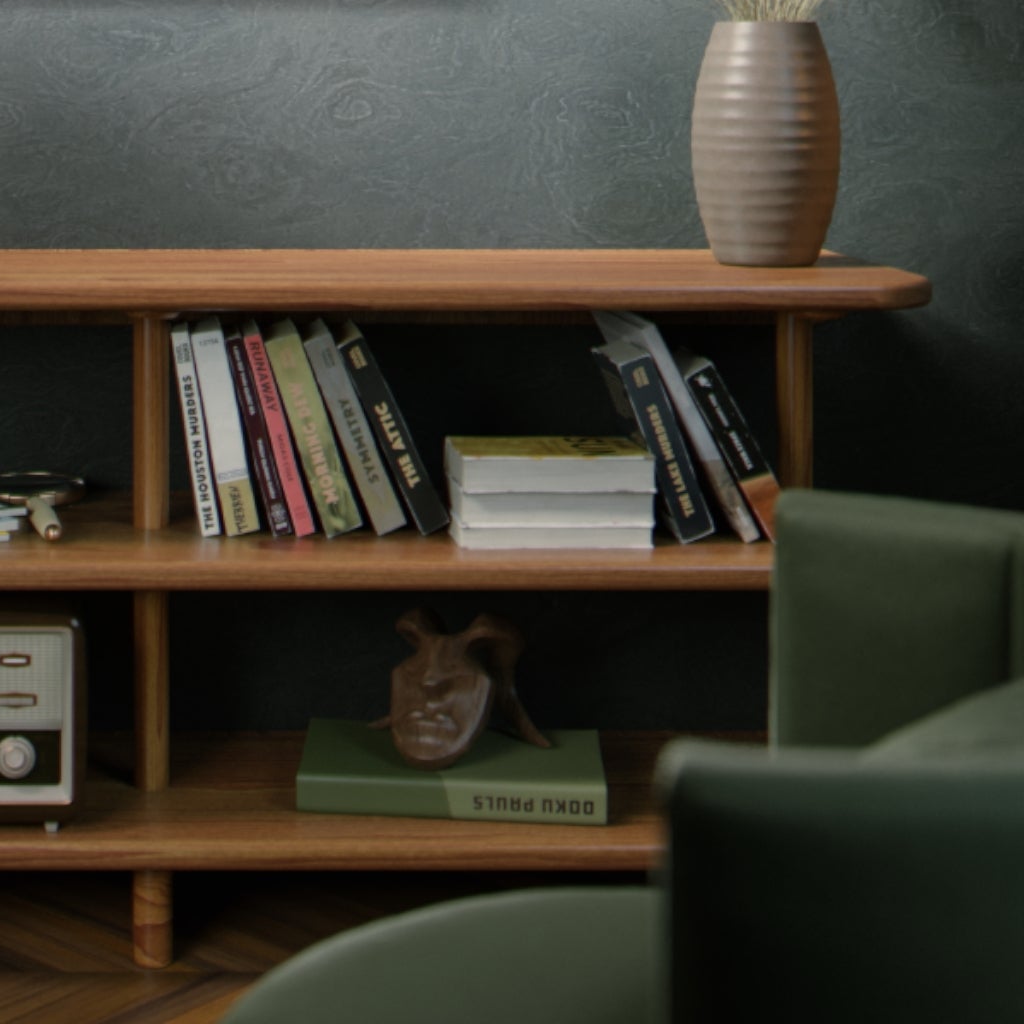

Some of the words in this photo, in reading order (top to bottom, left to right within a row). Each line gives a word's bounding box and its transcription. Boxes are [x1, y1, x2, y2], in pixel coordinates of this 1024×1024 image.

[250, 342, 277, 412] RUNAWAY
[183, 375, 202, 435] MURDERS
[374, 402, 405, 451] ATTIC
[340, 400, 379, 483] SYMMETRY
[646, 403, 674, 461] MURDERS
[191, 440, 209, 502] HOUSTON
[304, 422, 338, 504] MORNING
[398, 455, 421, 488] THE
[666, 462, 686, 493] LAKE
[202, 506, 214, 530] THE
[678, 493, 695, 519] THE
[473, 795, 534, 812] PAULS
[541, 798, 594, 815] DOKU
